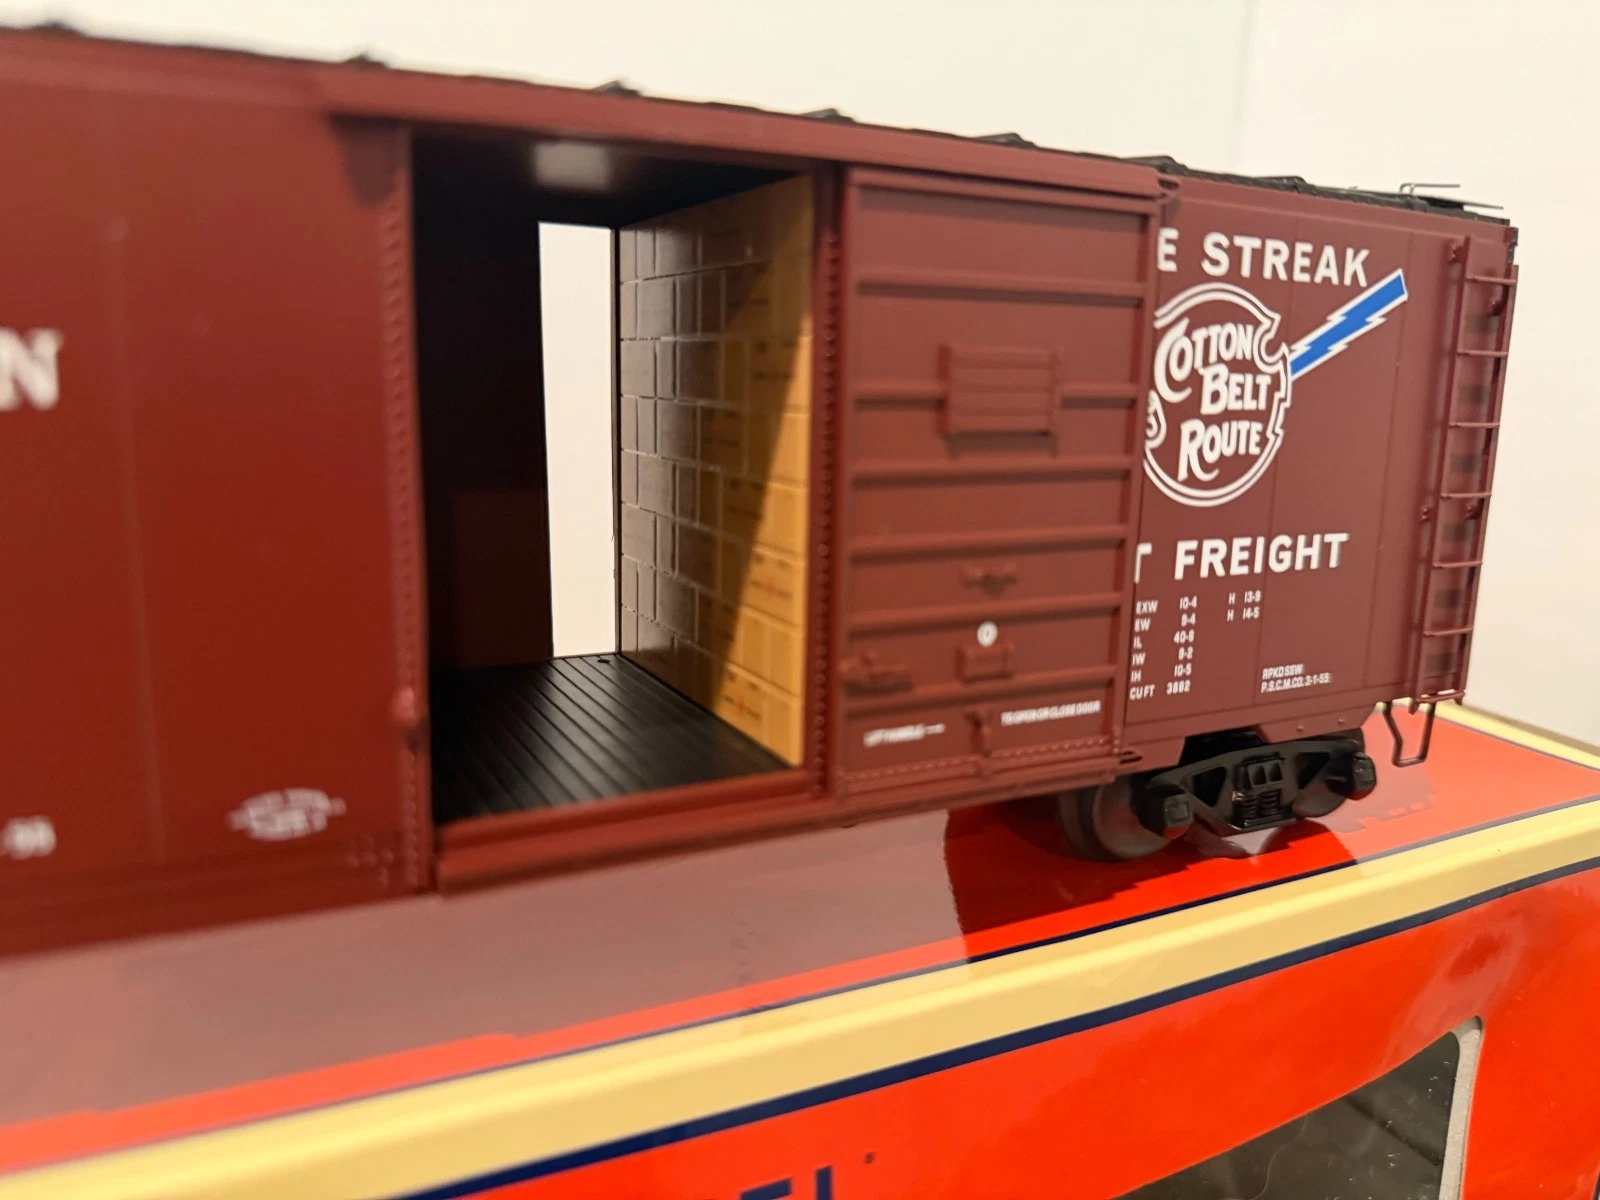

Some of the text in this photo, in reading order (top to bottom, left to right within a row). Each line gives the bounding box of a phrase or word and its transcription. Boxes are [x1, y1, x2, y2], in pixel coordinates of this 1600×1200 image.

[1200, 231, 1371, 288] STREAK
[1153, 316, 1255, 404] COTTON
[1199, 362, 1272, 416] BELT
[1177, 418, 1264, 482] ROUTE
[1173, 532, 1350, 581] FREIGHT
[1136, 595, 1198, 615] EXW 10-4
[1228, 592, 1236, 605] H
[1134, 618, 1151, 632] EW
[1226, 609, 1234, 622] H
[1133, 636, 1143, 649] IL
[1132, 652, 1146, 666] IW
[1130, 662, 1192, 683] IH 10-5
